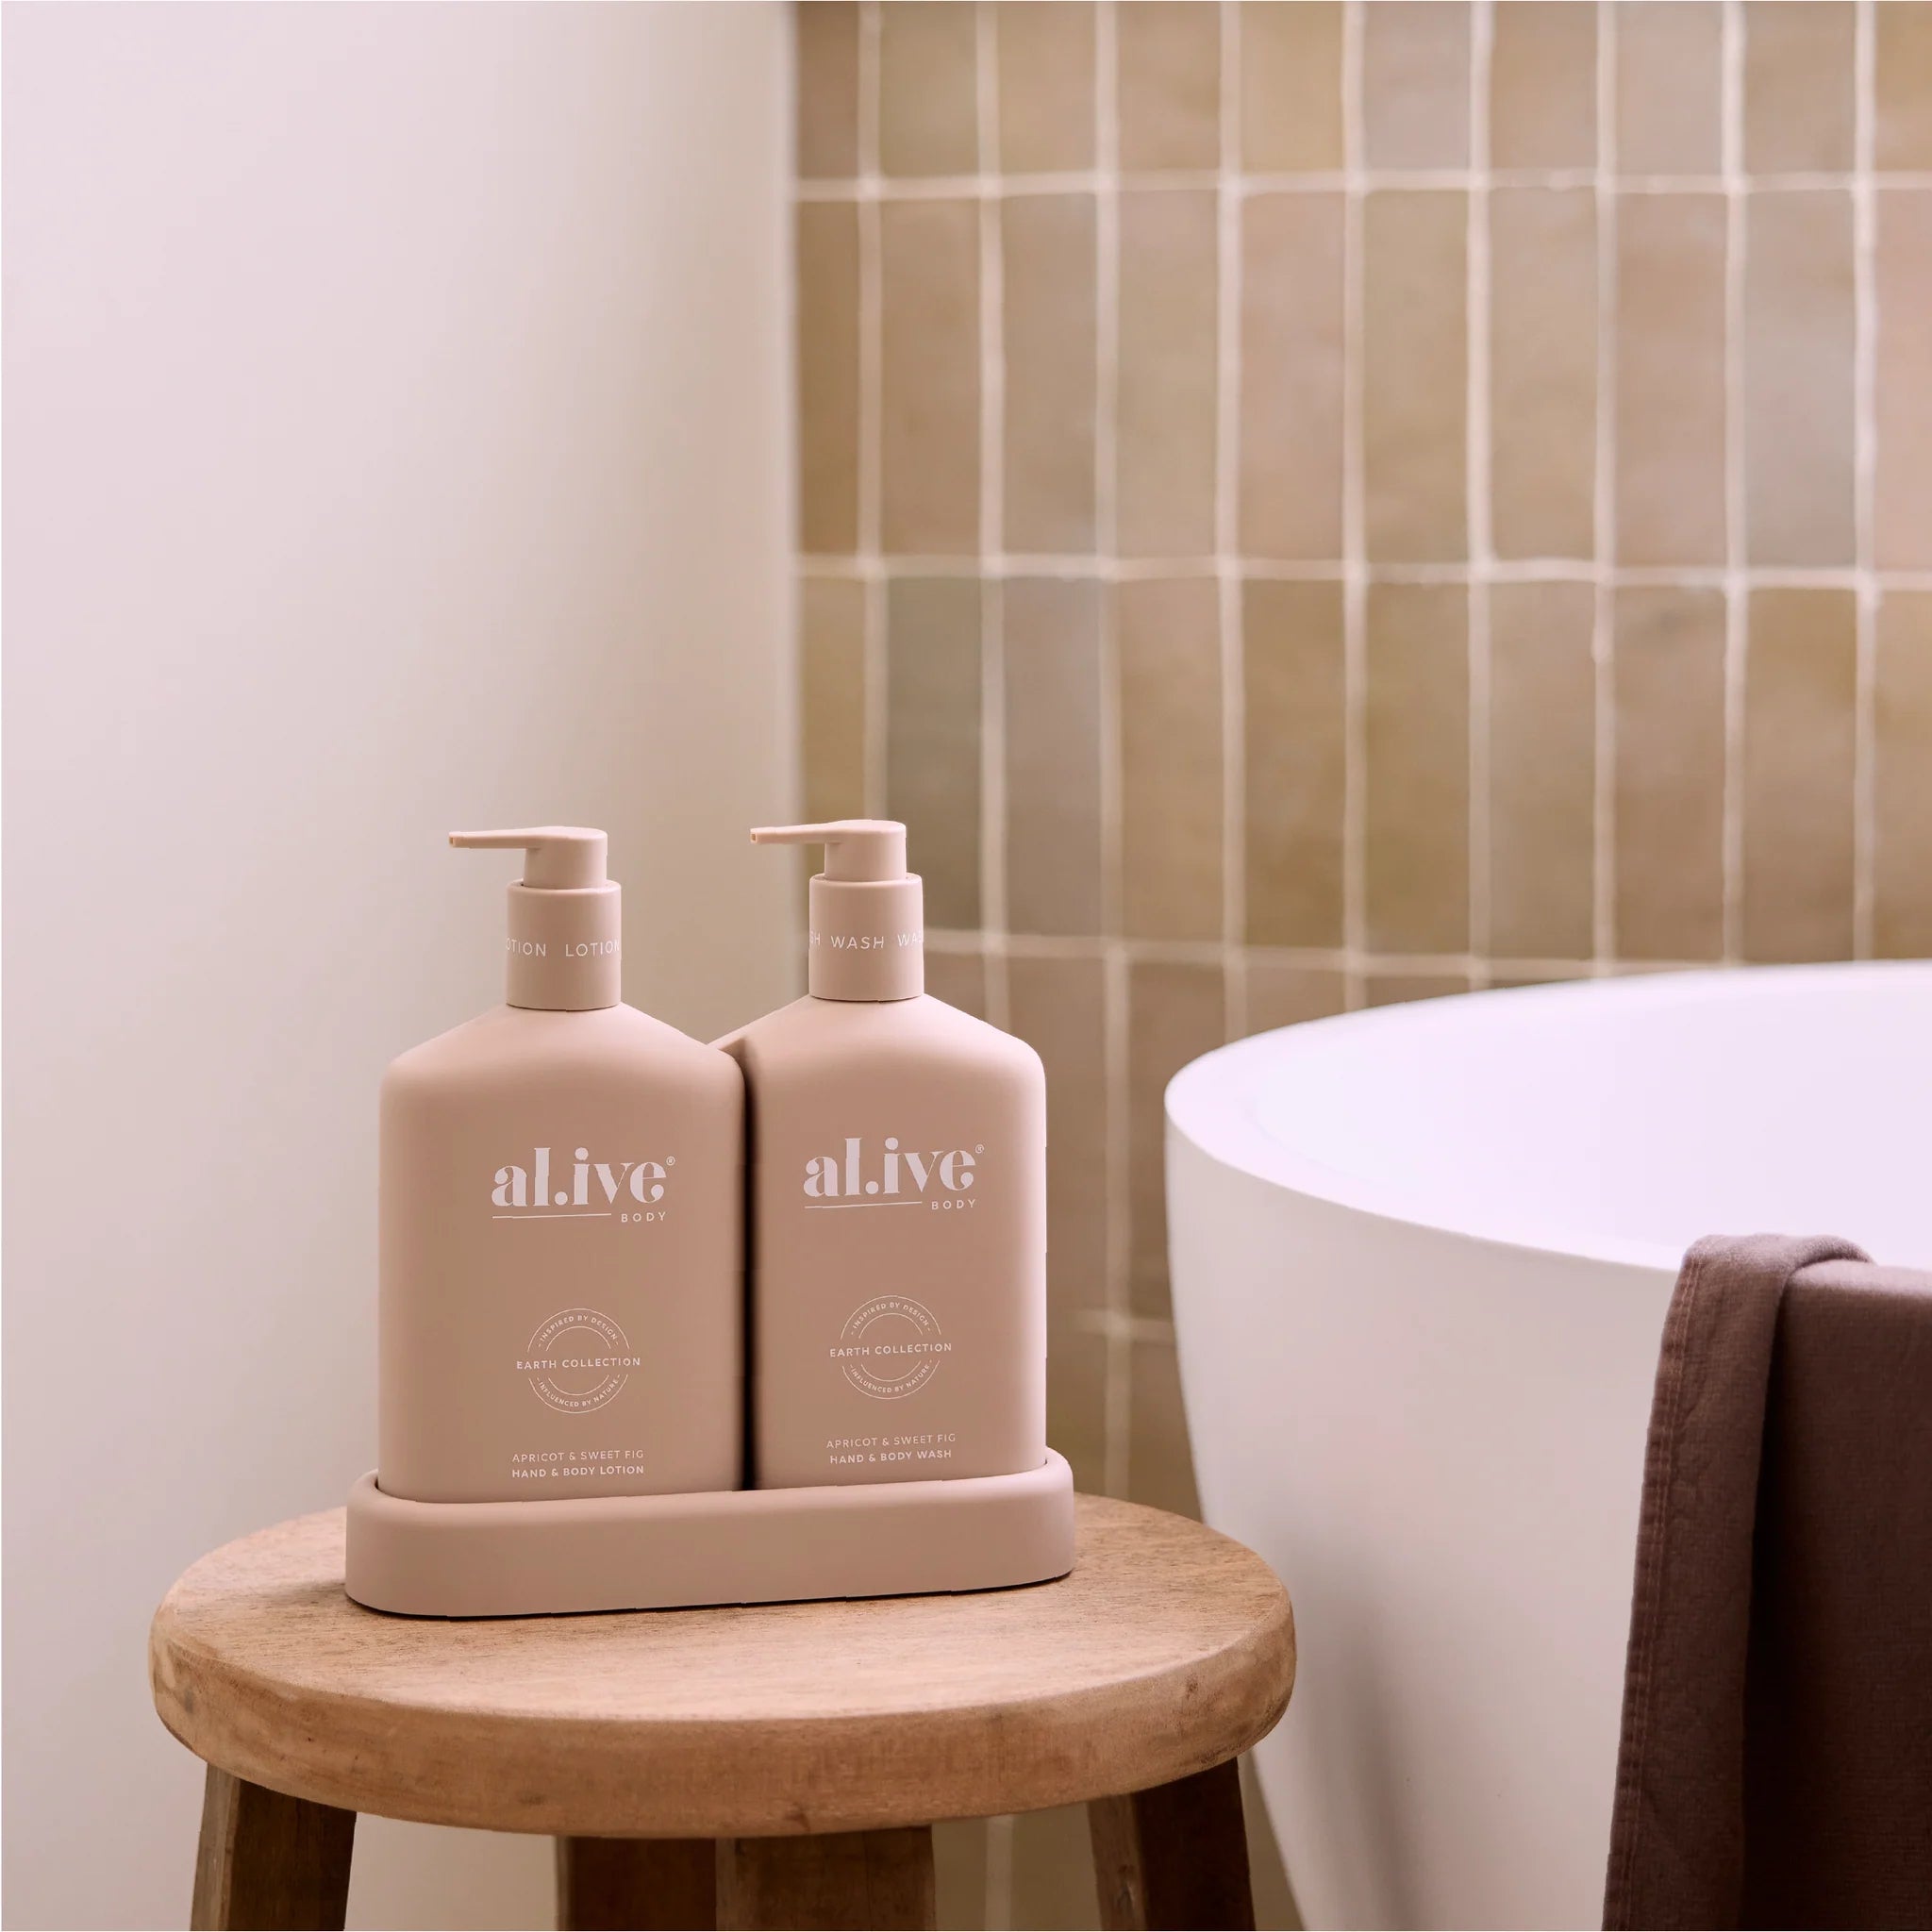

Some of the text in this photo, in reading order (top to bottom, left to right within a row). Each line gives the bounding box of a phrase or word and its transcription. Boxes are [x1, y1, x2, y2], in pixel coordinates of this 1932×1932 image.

[566, 939, 619, 957] LOTION
[831, 935, 884, 949] WASH
[932, 1199, 975, 1210] BODY
[622, 1211, 666, 1223] BODY
[852, 1303, 886, 1329] INSPIRED
[903, 1305, 929, 1326] DESIGN
[540, 1316, 575, 1342] INSPIRED
[591, 1317, 618, 1341] DESIGN
[830, 1343, 952, 1357] EARTH COLLECTION
[516, 1357, 641, 1370] EARTH COLLECTION
[851, 1368, 892, 1393] INFLUENCED
[907, 1364, 930, 1388] NATURE
[539, 1381, 579, 1407] INFLUENCED
[593, 1378, 619, 1403] NATURE
[826, 1433, 956, 1449] APRICOT & SWEET FIG
[512, 1450, 643, 1463] APRICOT & SWEET FIG
[829, 1450, 952, 1464] HAND & BODY WASH
[512, 1466, 643, 1478] HAND & BODY LOTION
